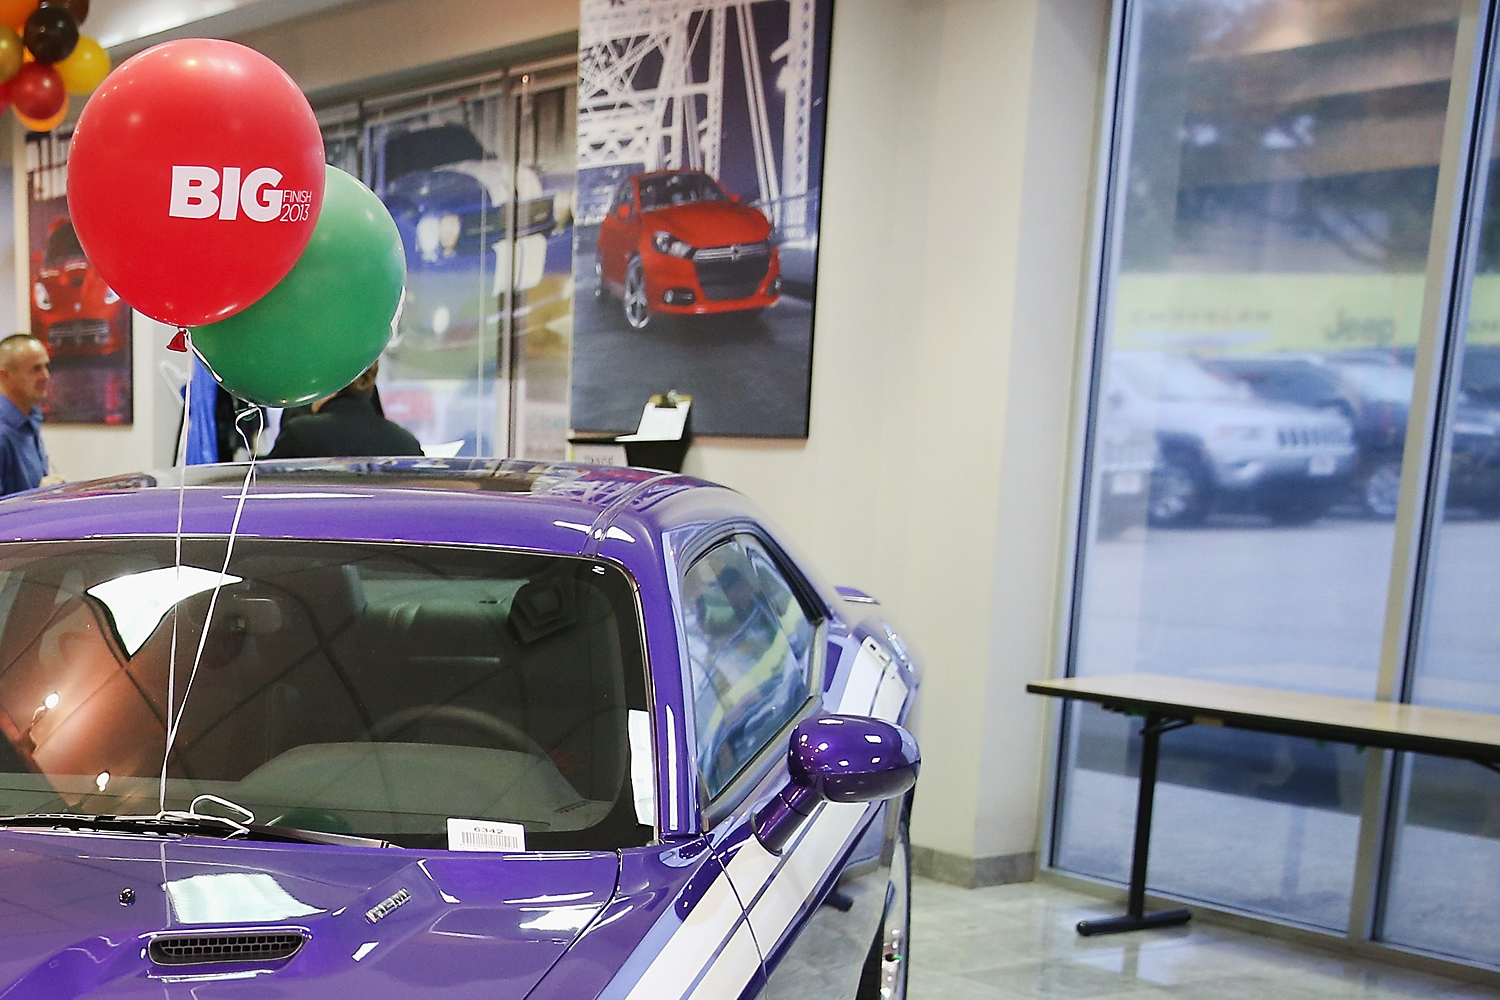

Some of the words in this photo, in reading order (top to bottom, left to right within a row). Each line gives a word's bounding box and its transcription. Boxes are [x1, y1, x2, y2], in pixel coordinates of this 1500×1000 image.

[169, 165, 284, 222] BIG
[282, 190, 312, 203] FINISH
[279, 203, 311, 222] 2013
[473, 826, 505, 835] 6342
[365, 888, 412, 923] HEMI
